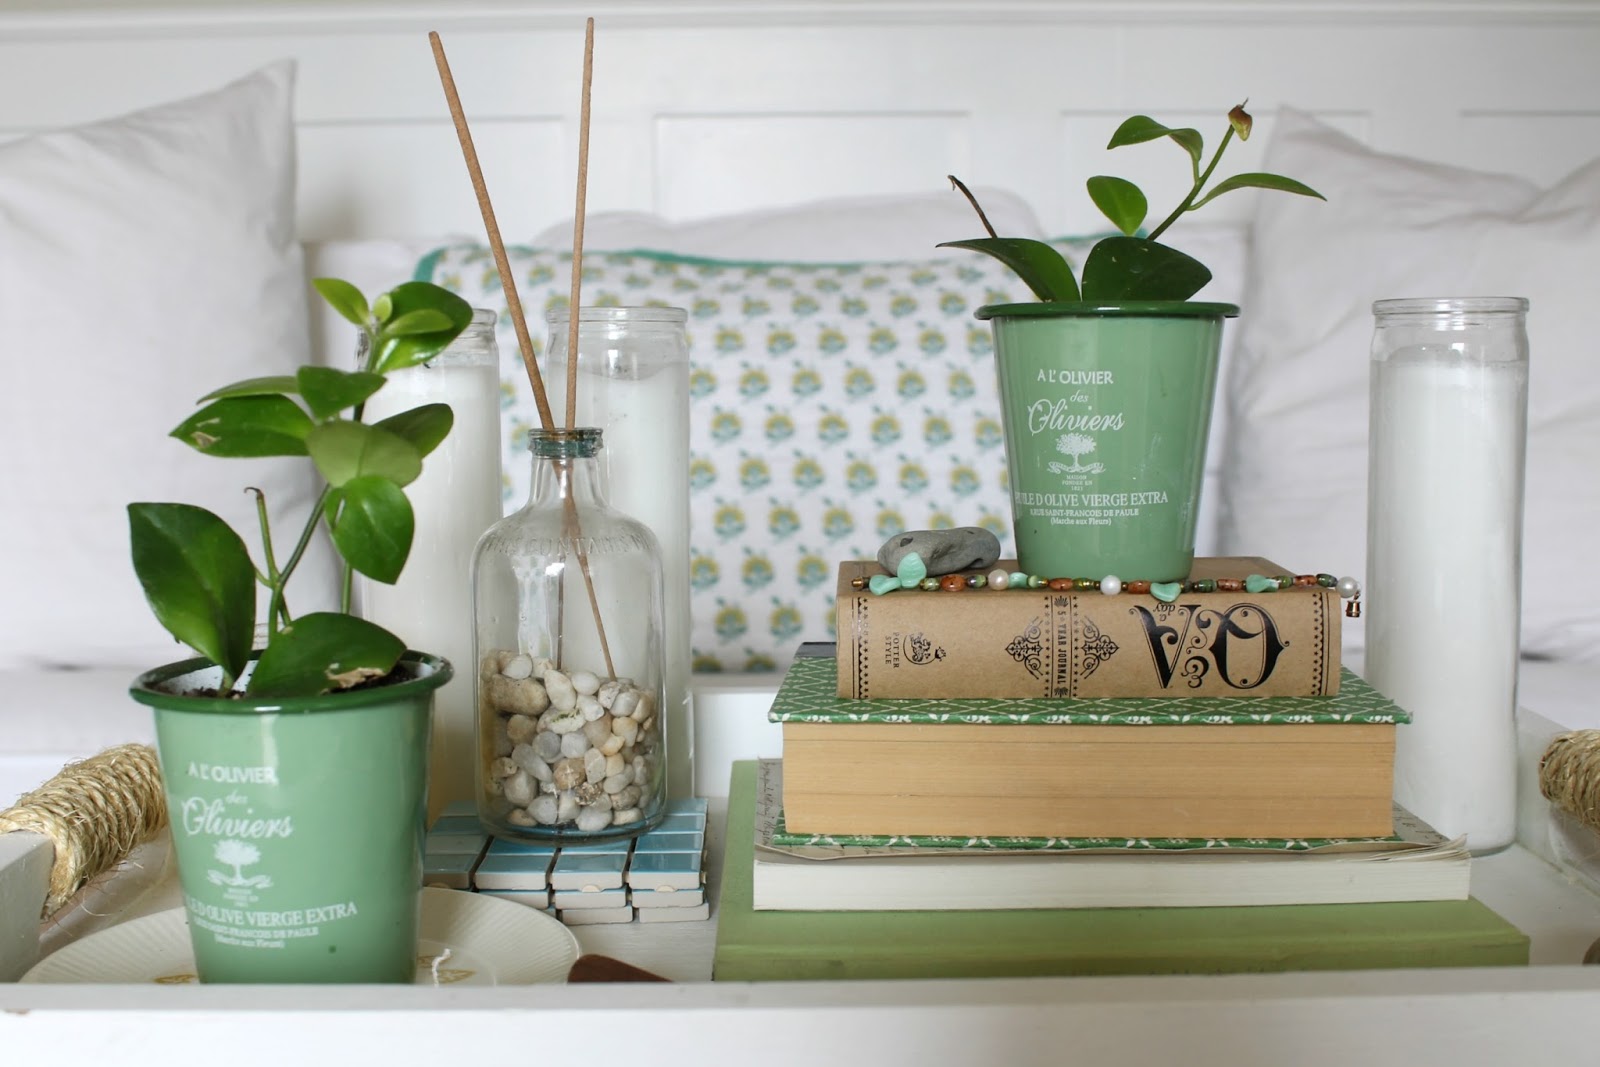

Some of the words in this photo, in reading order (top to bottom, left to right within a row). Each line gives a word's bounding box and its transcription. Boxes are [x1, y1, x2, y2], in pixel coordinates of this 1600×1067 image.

[1069, 390, 1089, 403] des
[1027, 398, 1125, 436] Oliviers
[1081, 493, 1128, 507] VIERGE
[1130, 491, 1169, 505] EXTRA
[1115, 508, 1140, 517] PAULE
[1152, 602, 1176, 616] day
[1057, 648, 1067, 685] JOURNAL
[181, 796, 292, 838] Oliviers
[245, 911, 304, 927] VIERGE
[306, 901, 358, 924] EXTRA
